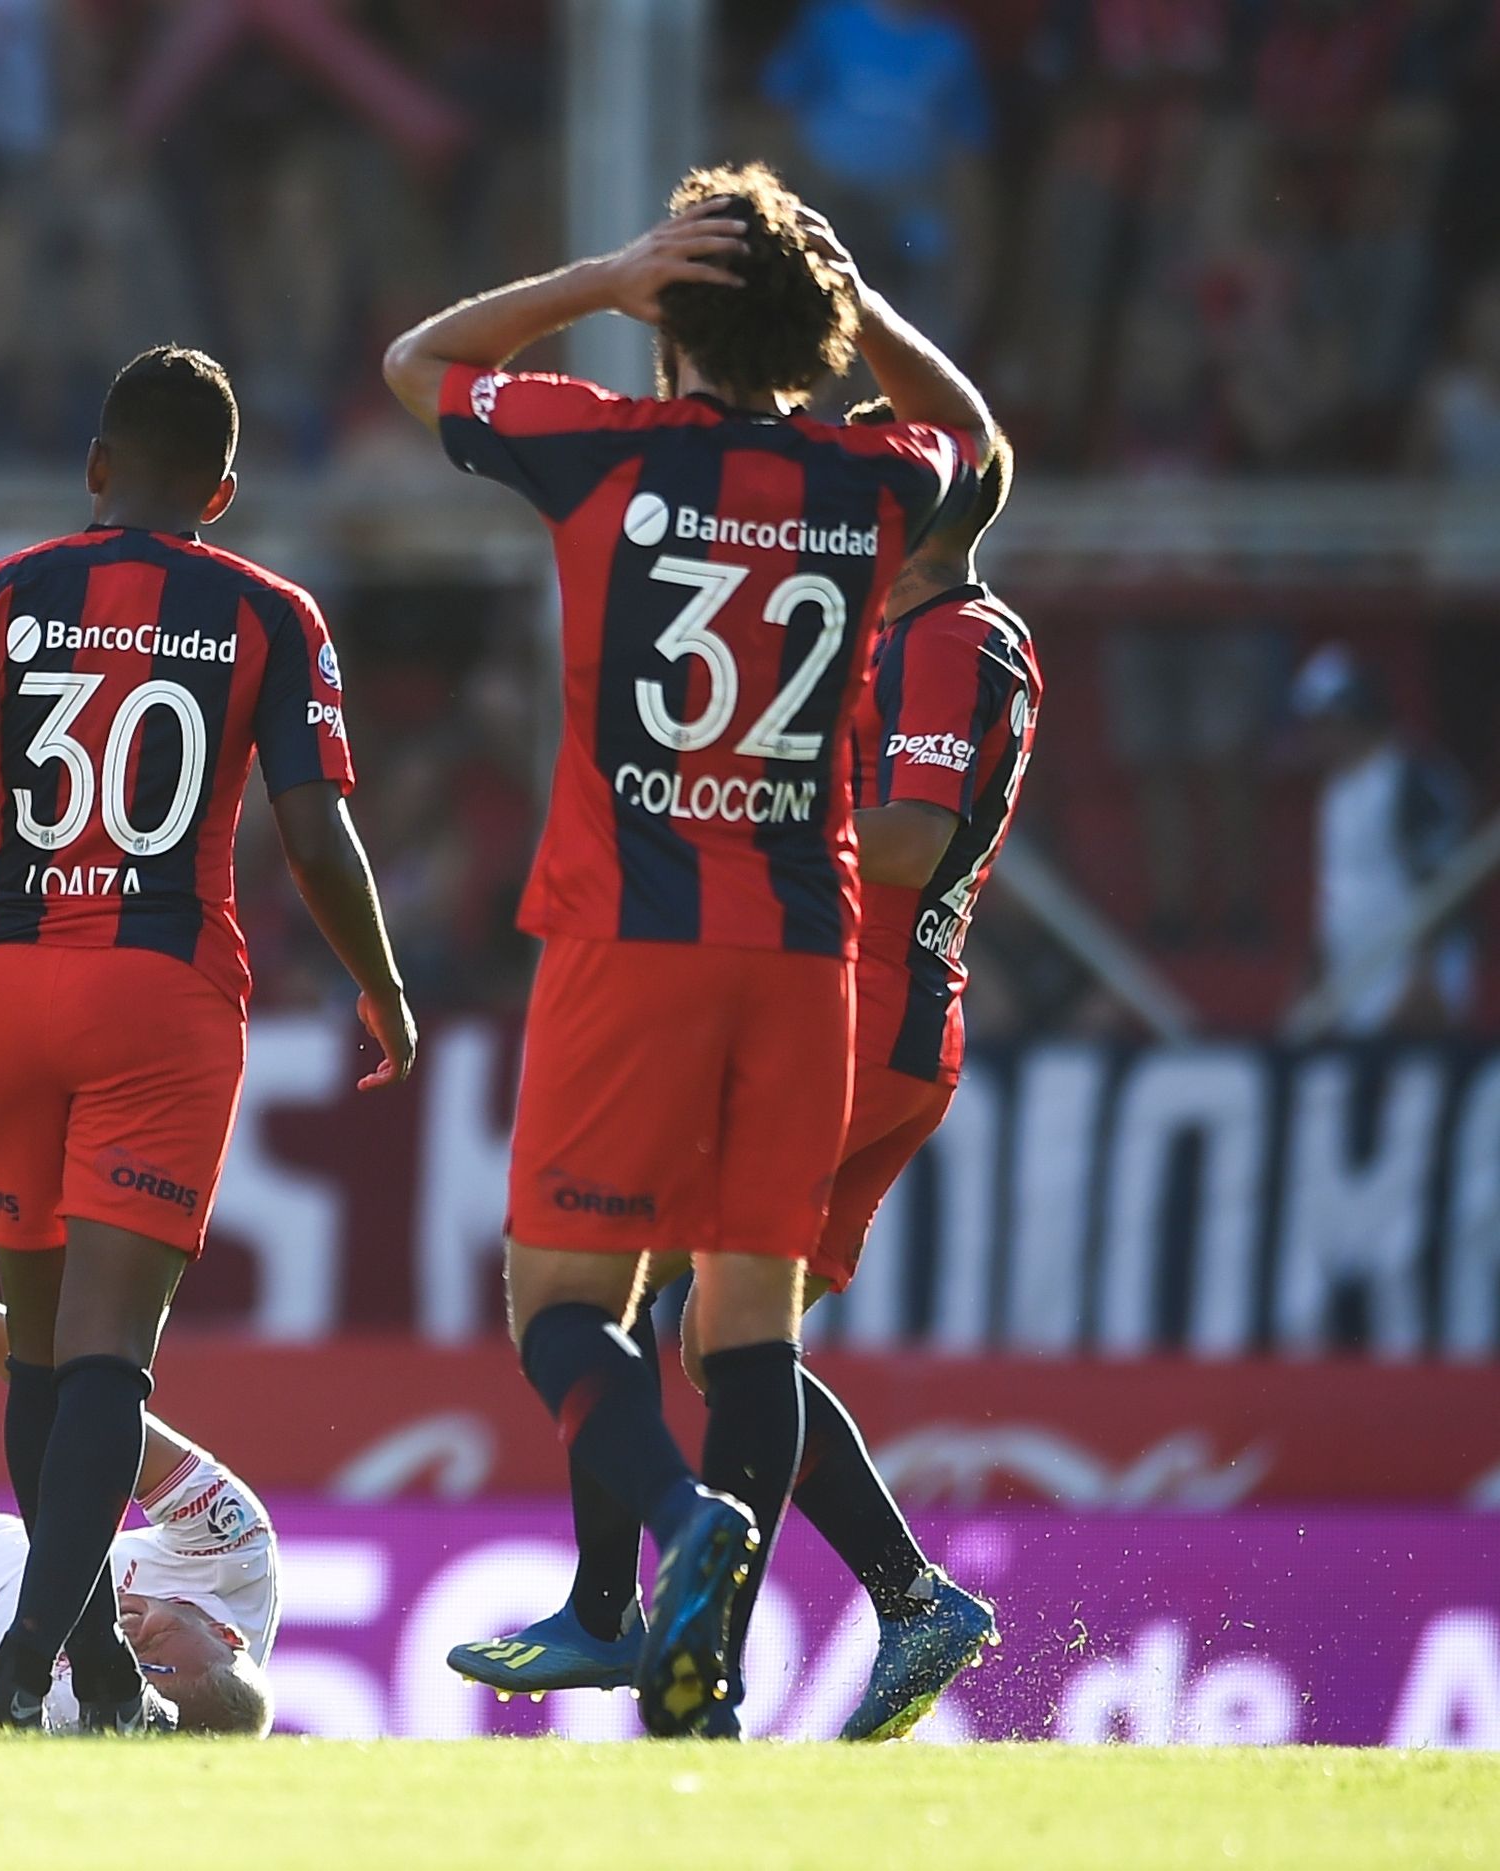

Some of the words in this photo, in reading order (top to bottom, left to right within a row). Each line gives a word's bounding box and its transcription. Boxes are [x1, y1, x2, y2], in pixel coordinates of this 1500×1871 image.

[674, 505, 880, 557] BancoCiudad
[45, 619, 238, 665] BancoCiudad
[634, 554, 848, 762] 32
[11, 670, 207, 857] 30
[885, 732, 977, 765] Dexter
[110, 1166, 199, 1216] ORBIS
[554, 1187, 656, 1222] ORBIS
